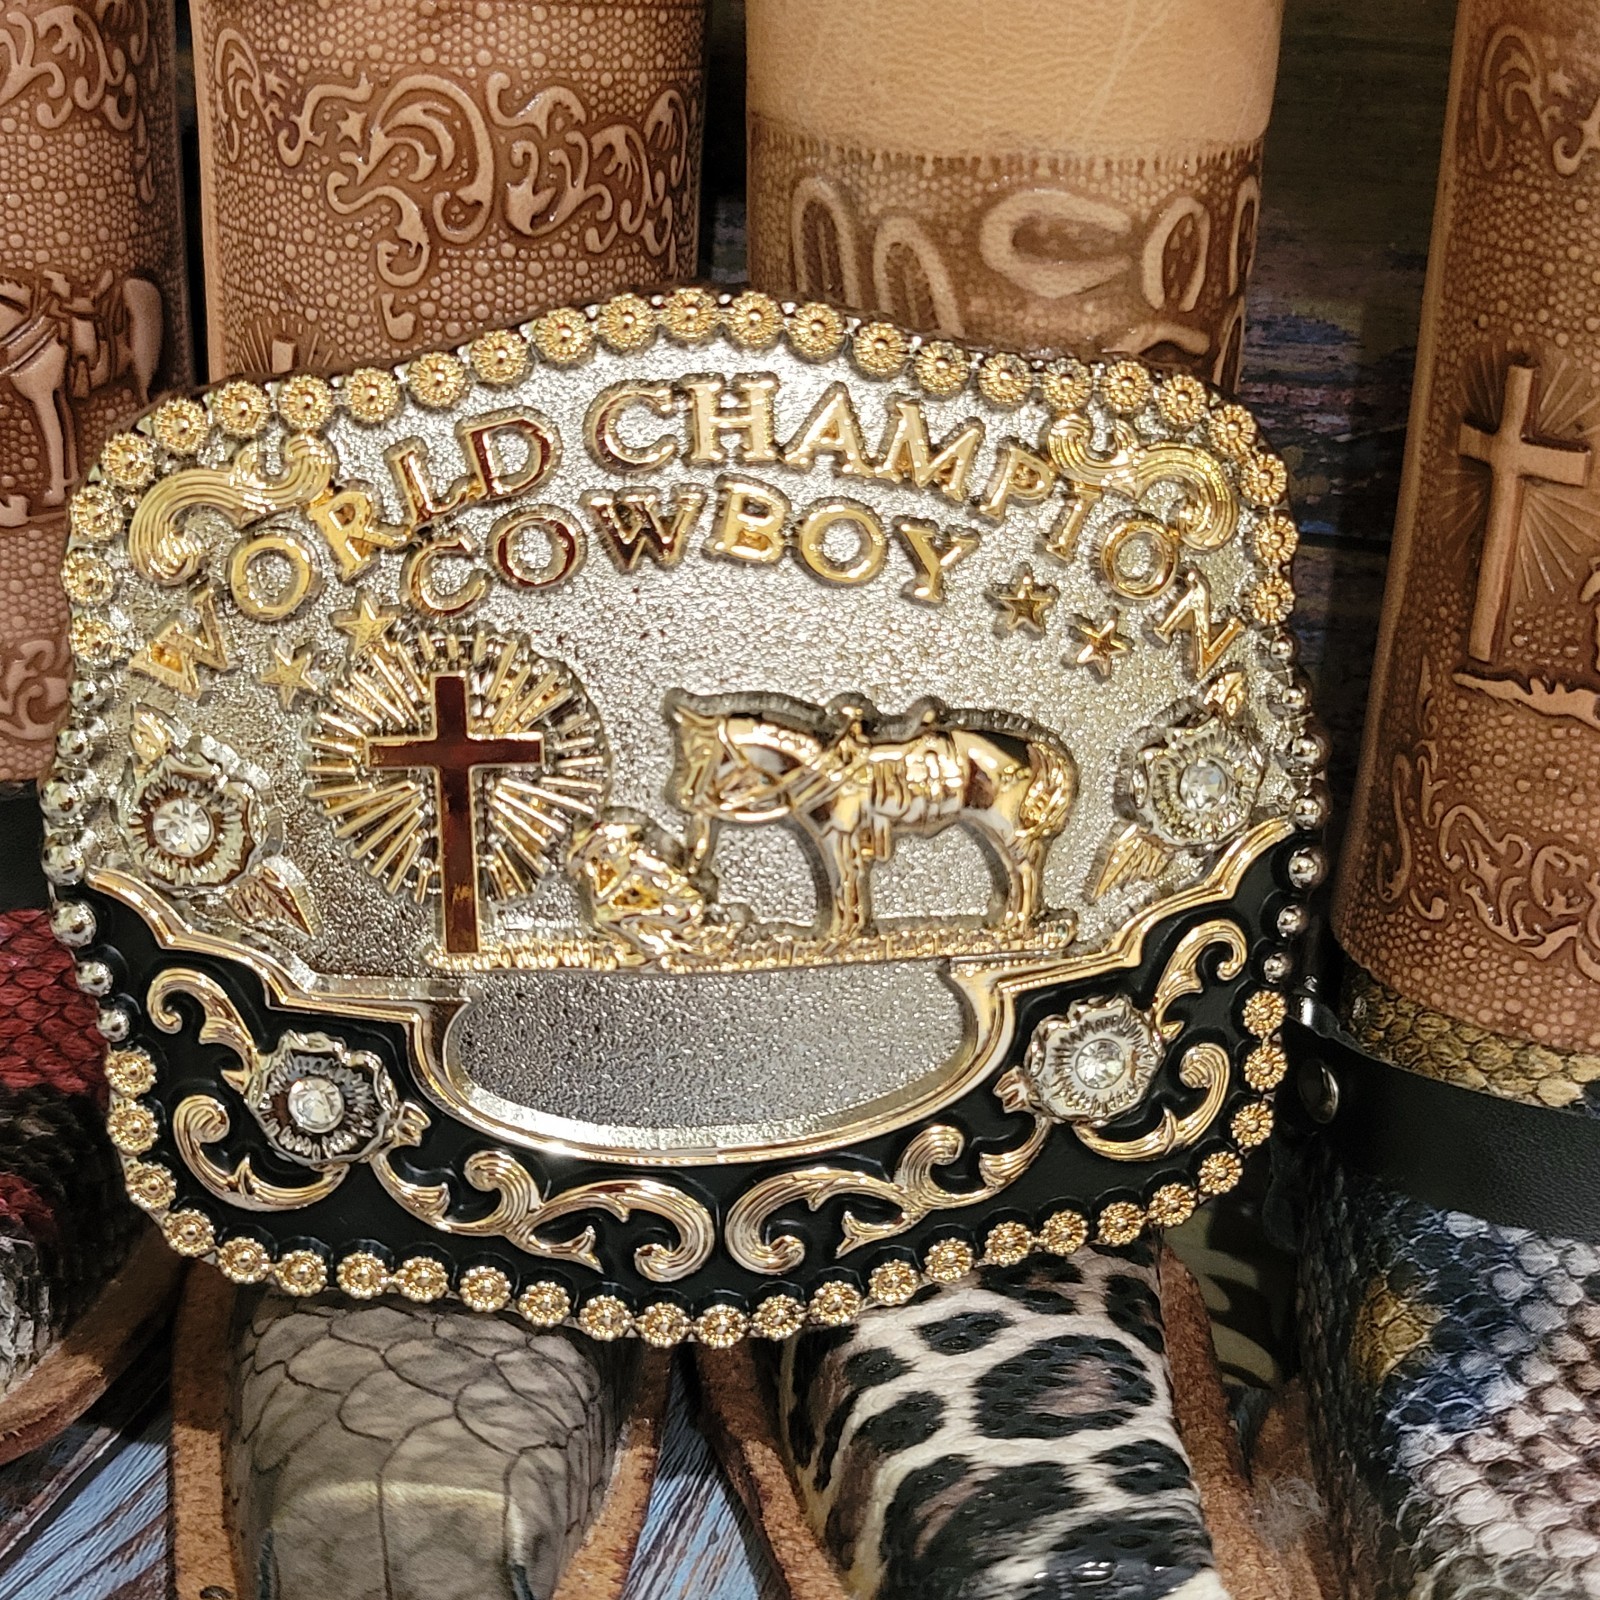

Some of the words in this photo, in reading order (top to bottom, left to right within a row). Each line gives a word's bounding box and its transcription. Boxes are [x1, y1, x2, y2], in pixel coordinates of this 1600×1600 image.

[131, 407, 561, 697] WORLD
[586, 374, 1244, 680] CHAMPION
[402, 476, 977, 616] COWBOY
